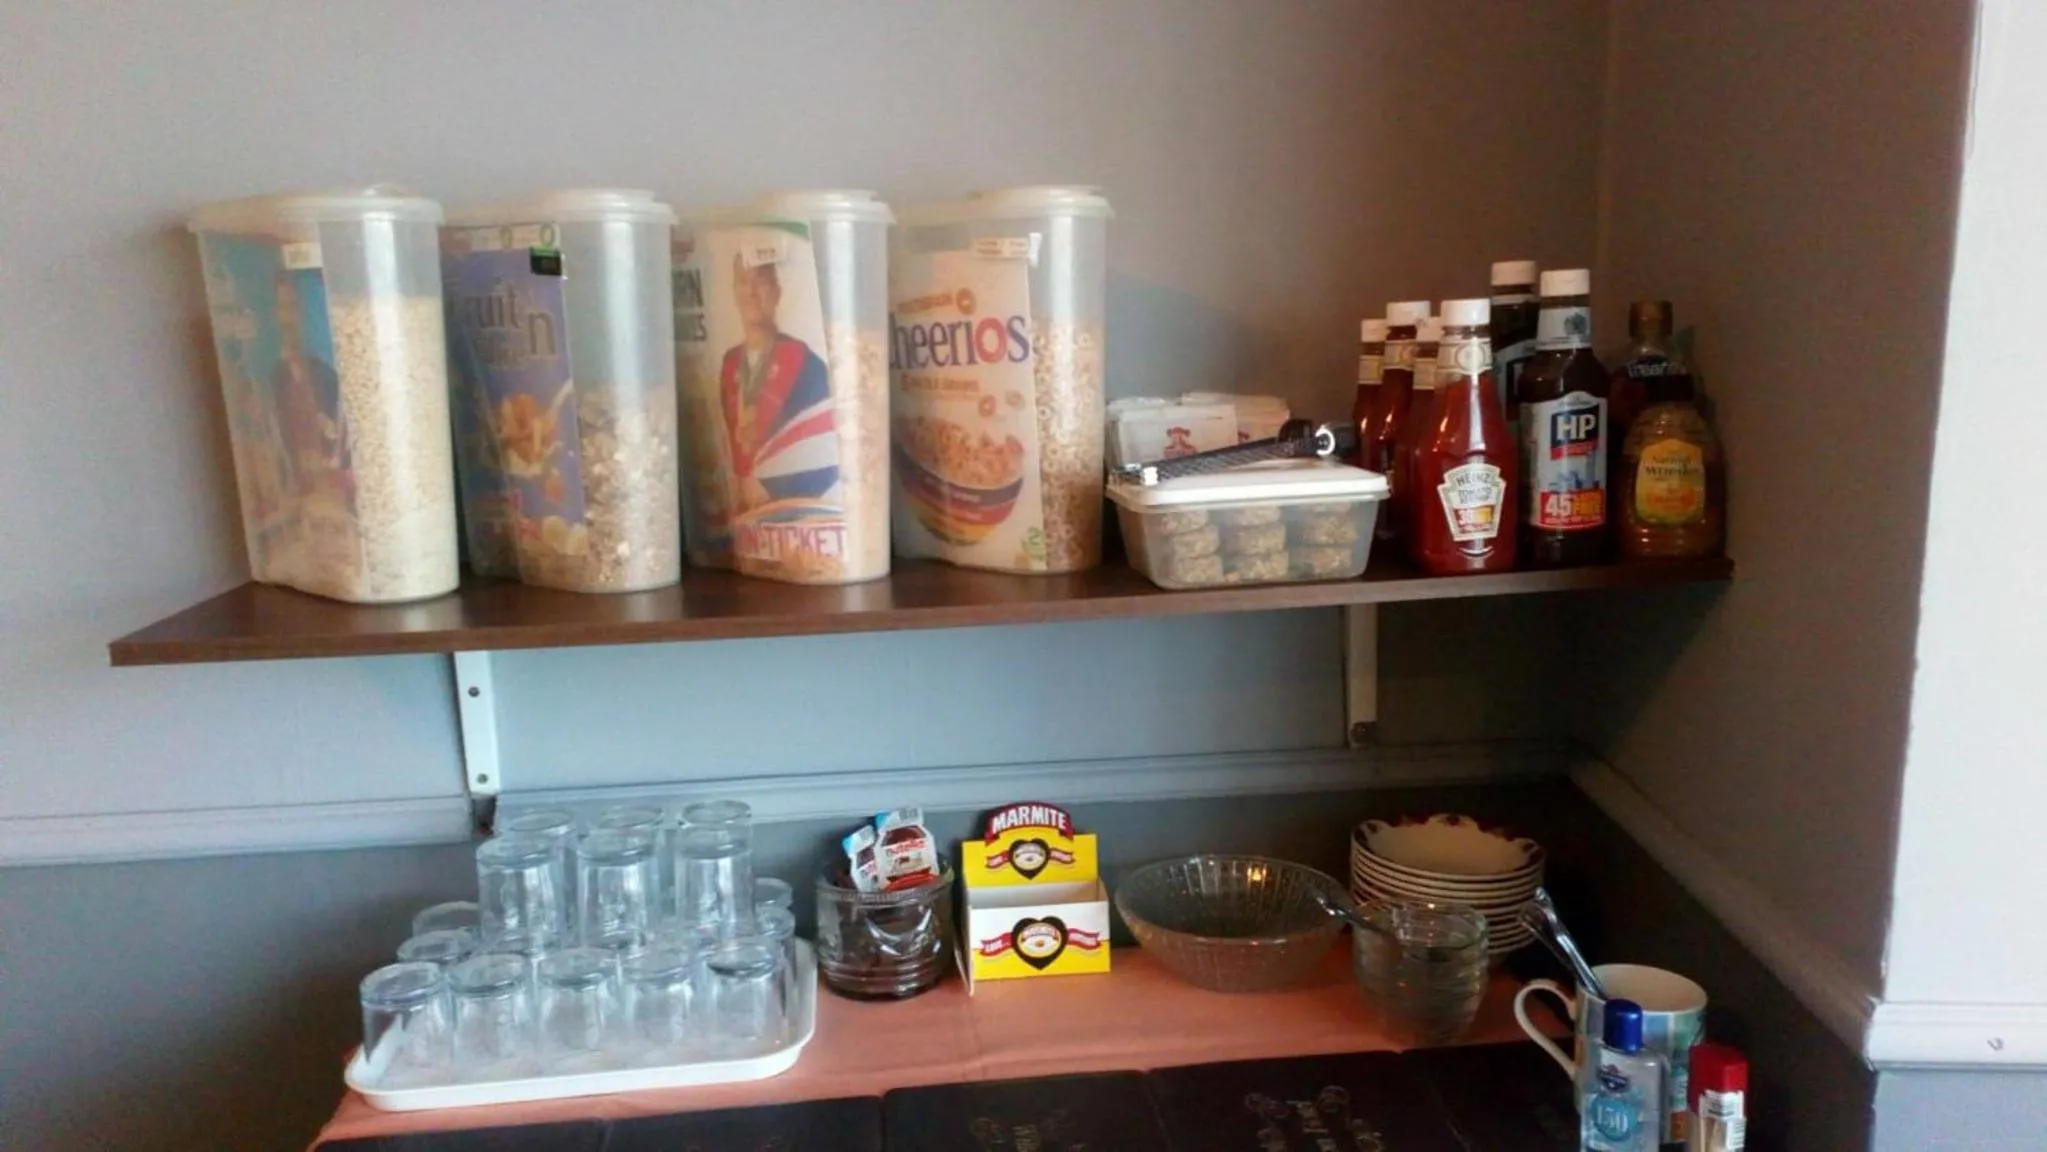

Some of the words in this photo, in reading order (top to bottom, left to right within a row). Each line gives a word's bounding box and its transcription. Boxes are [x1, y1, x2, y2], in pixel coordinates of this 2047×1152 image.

[1556, 413, 1597, 441] HP
[1544, 492, 1573, 517] 45
[991, 806, 1068, 834] MARMITE
